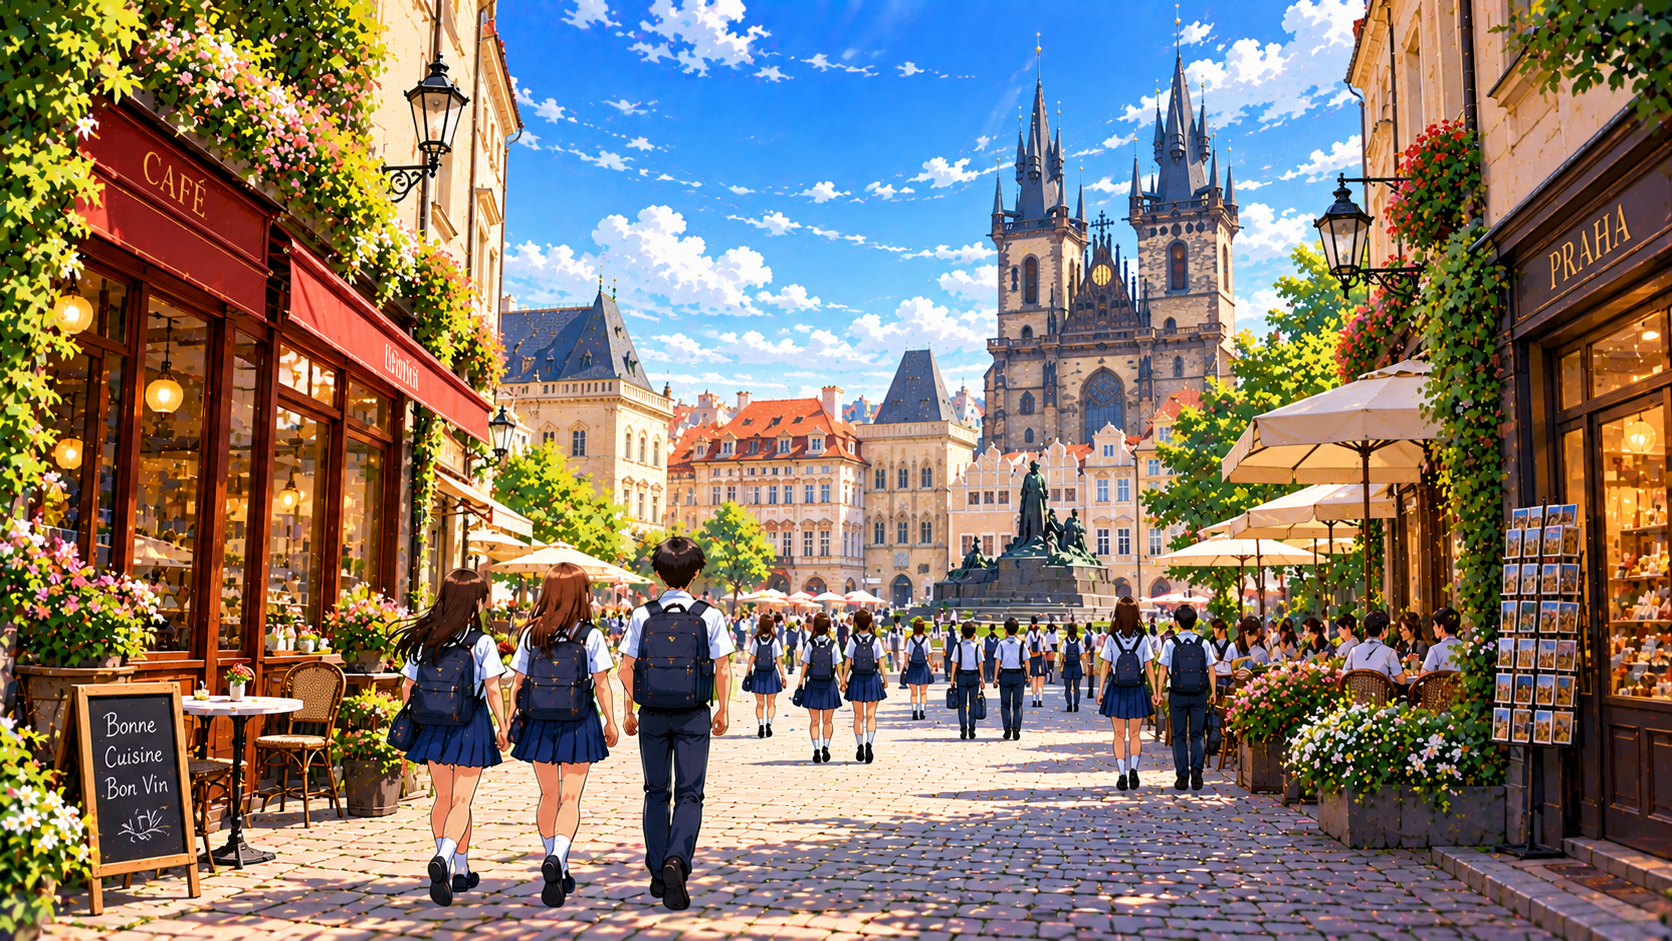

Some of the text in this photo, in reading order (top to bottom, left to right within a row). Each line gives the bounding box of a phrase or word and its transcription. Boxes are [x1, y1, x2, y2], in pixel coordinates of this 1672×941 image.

[143, 151, 207, 218] CAFÉ
[1548, 203, 1632, 291] PRAHA
[103, 711, 157, 738] Bonne
[104, 745, 163, 768] Cuisine
[104, 773, 169, 800] Bon Vin
